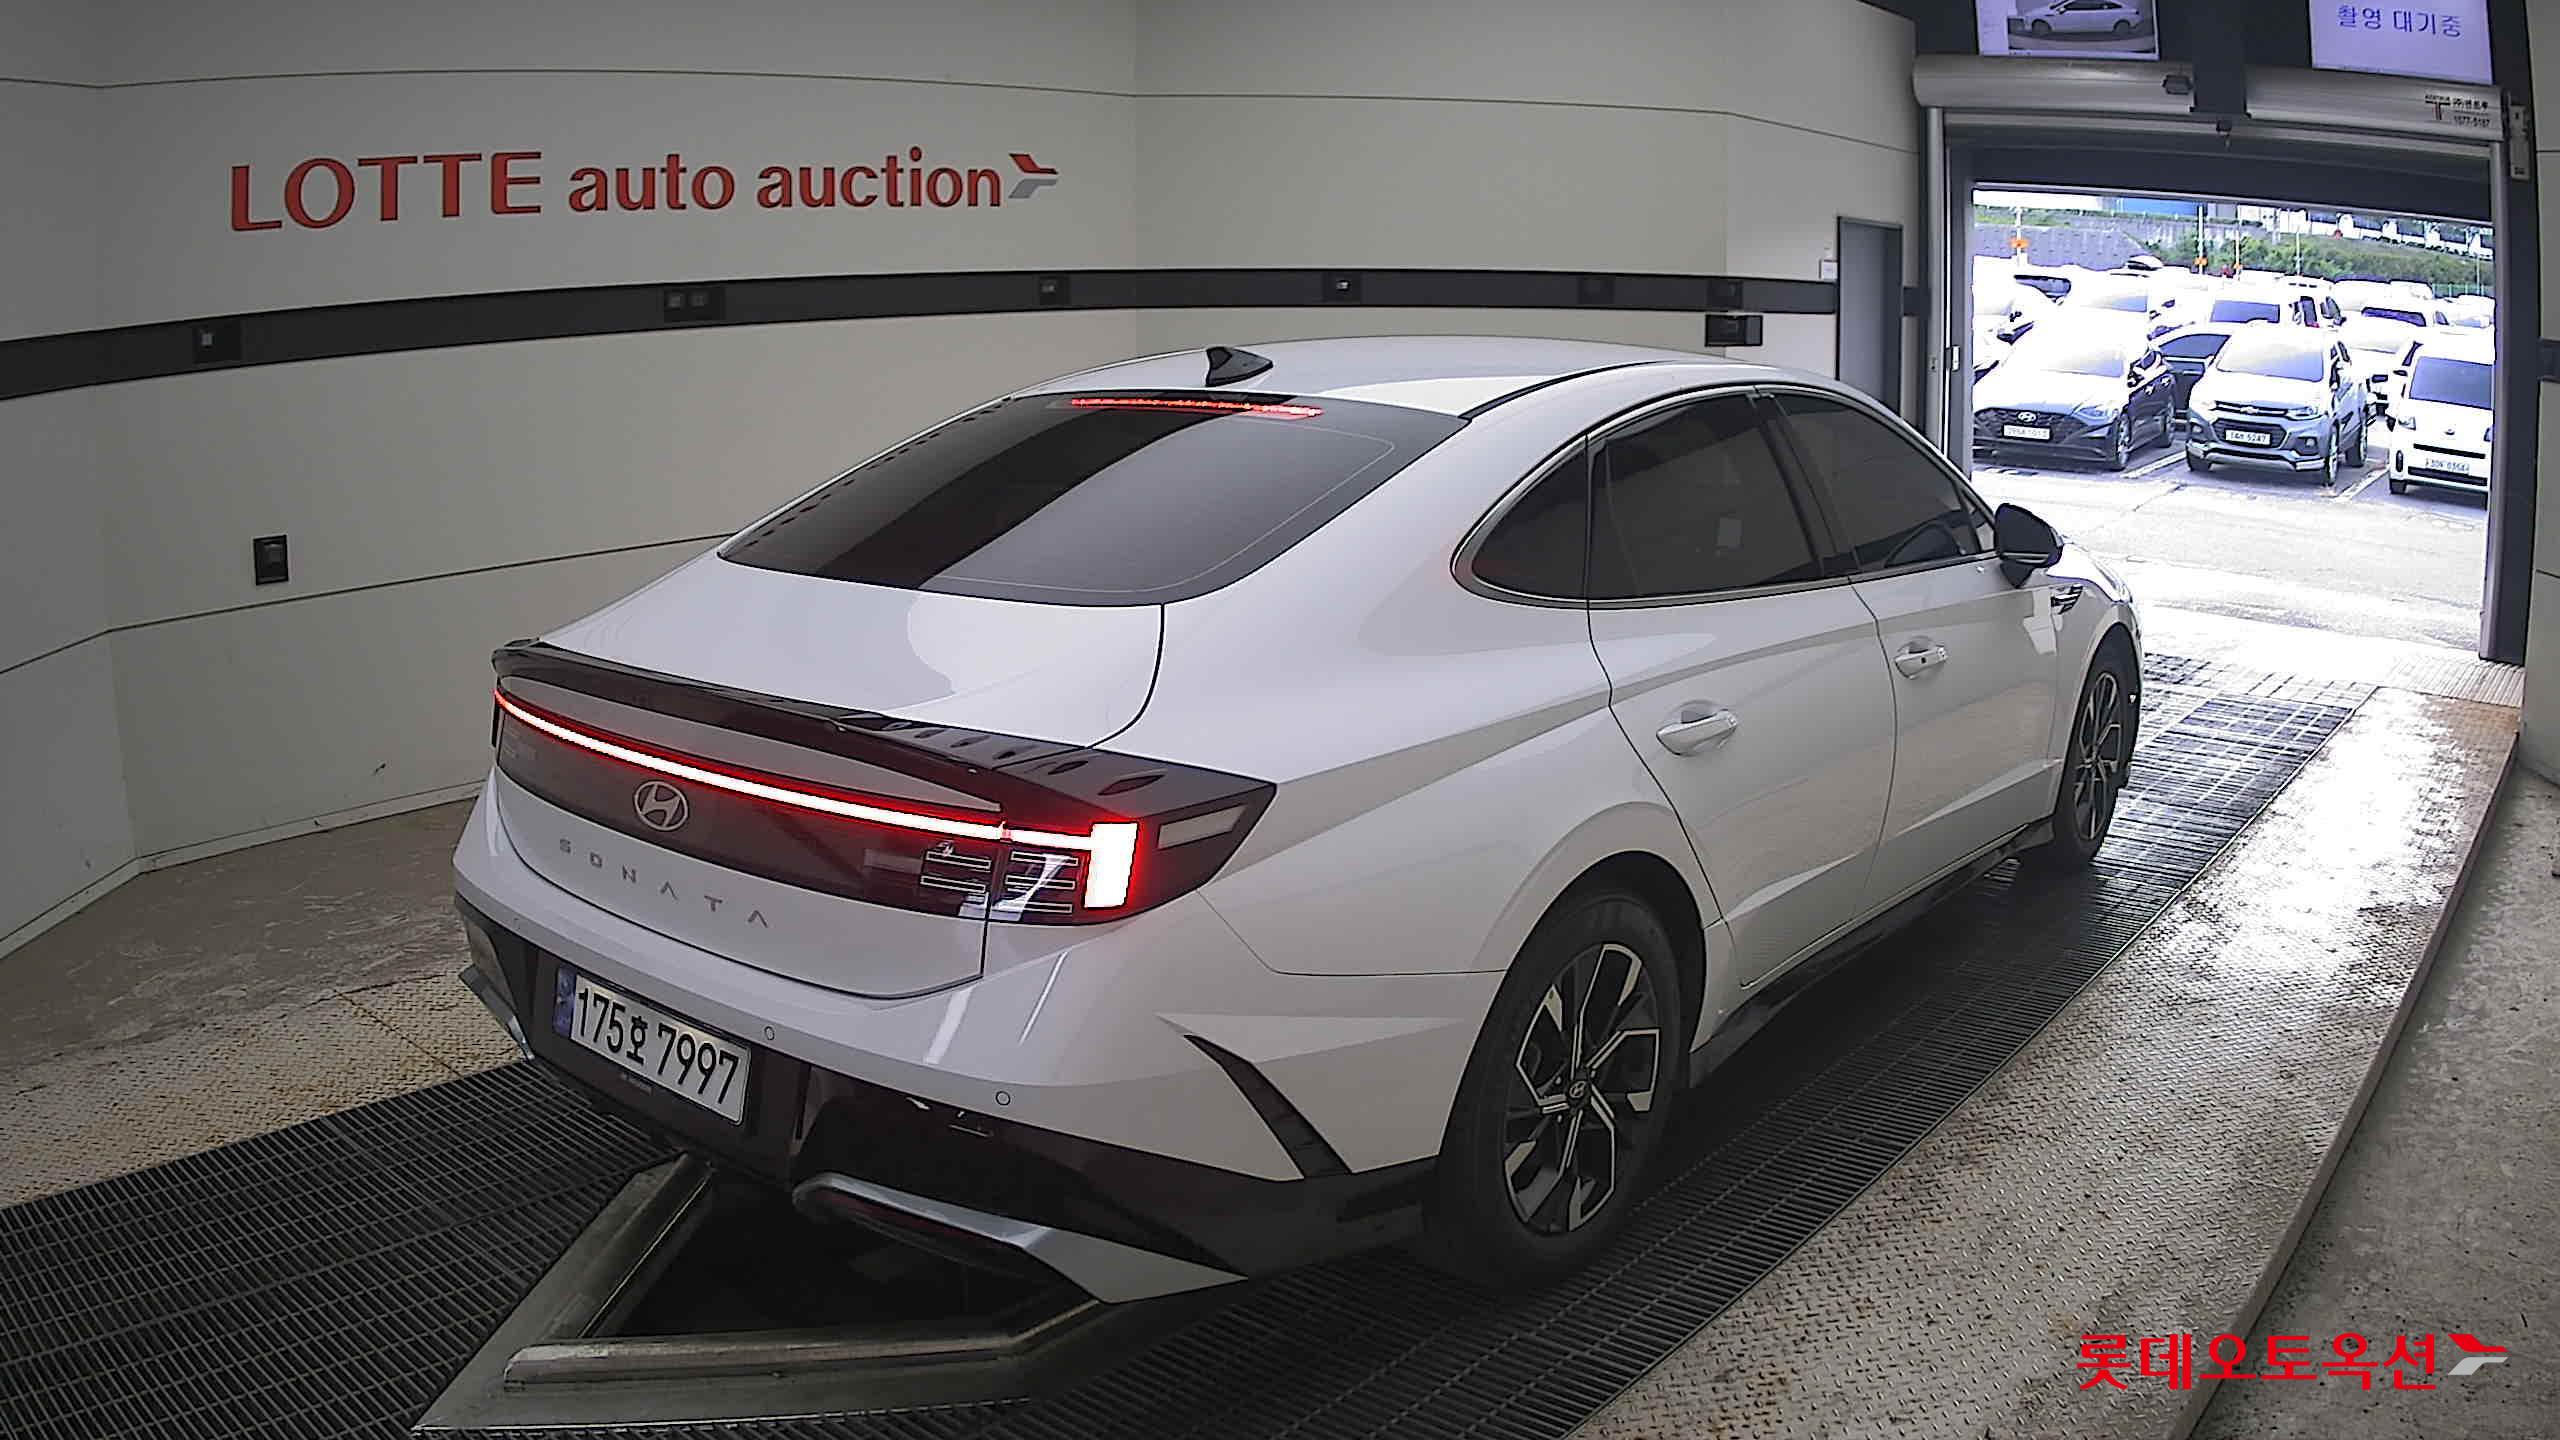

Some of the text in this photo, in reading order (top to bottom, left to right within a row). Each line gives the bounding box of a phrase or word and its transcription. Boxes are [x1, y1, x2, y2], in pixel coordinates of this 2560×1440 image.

[2337, 4, 2461, 38] 촬영 대기중
[230, 146, 1003, 232] LOTTE auto auction
[559, 837, 769, 929] SONATA
[577, 986, 741, 1106] 175호 7997
